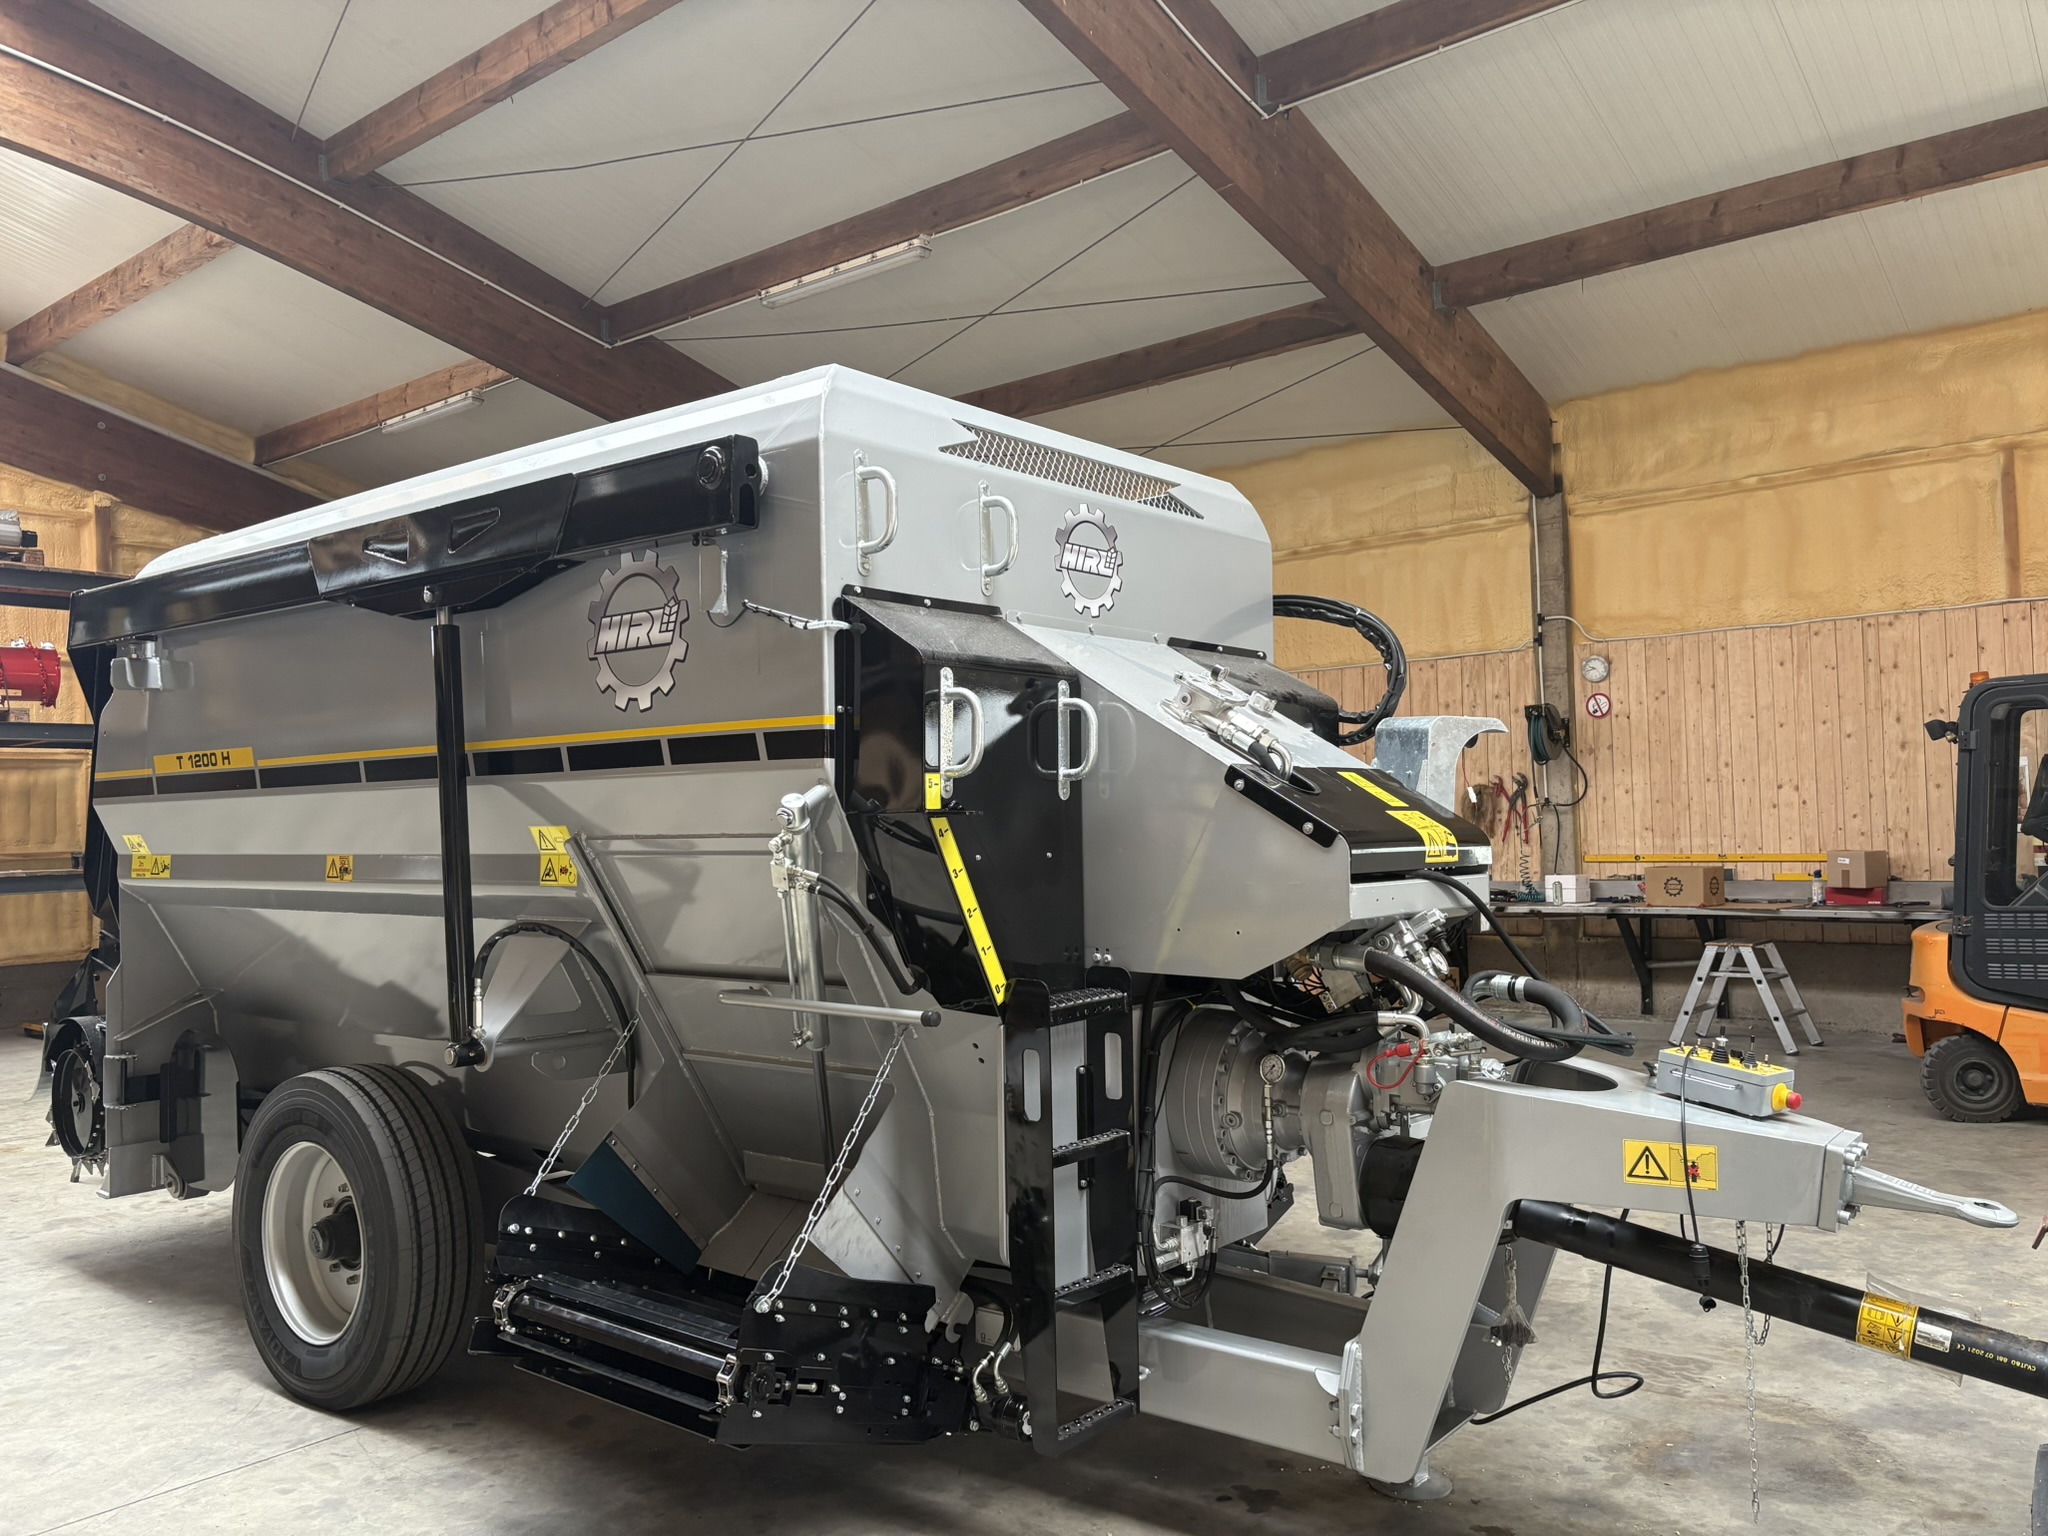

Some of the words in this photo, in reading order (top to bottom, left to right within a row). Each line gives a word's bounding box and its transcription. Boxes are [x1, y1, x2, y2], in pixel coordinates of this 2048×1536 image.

[1060, 541, 1117, 578] HIRL
[594, 599, 680, 655] HIRL
[176, 756, 183, 769] T
[188, 752, 217, 768] 1200
[221, 751, 231, 766] H
[1967, 1346, 1984, 1356] 2021
